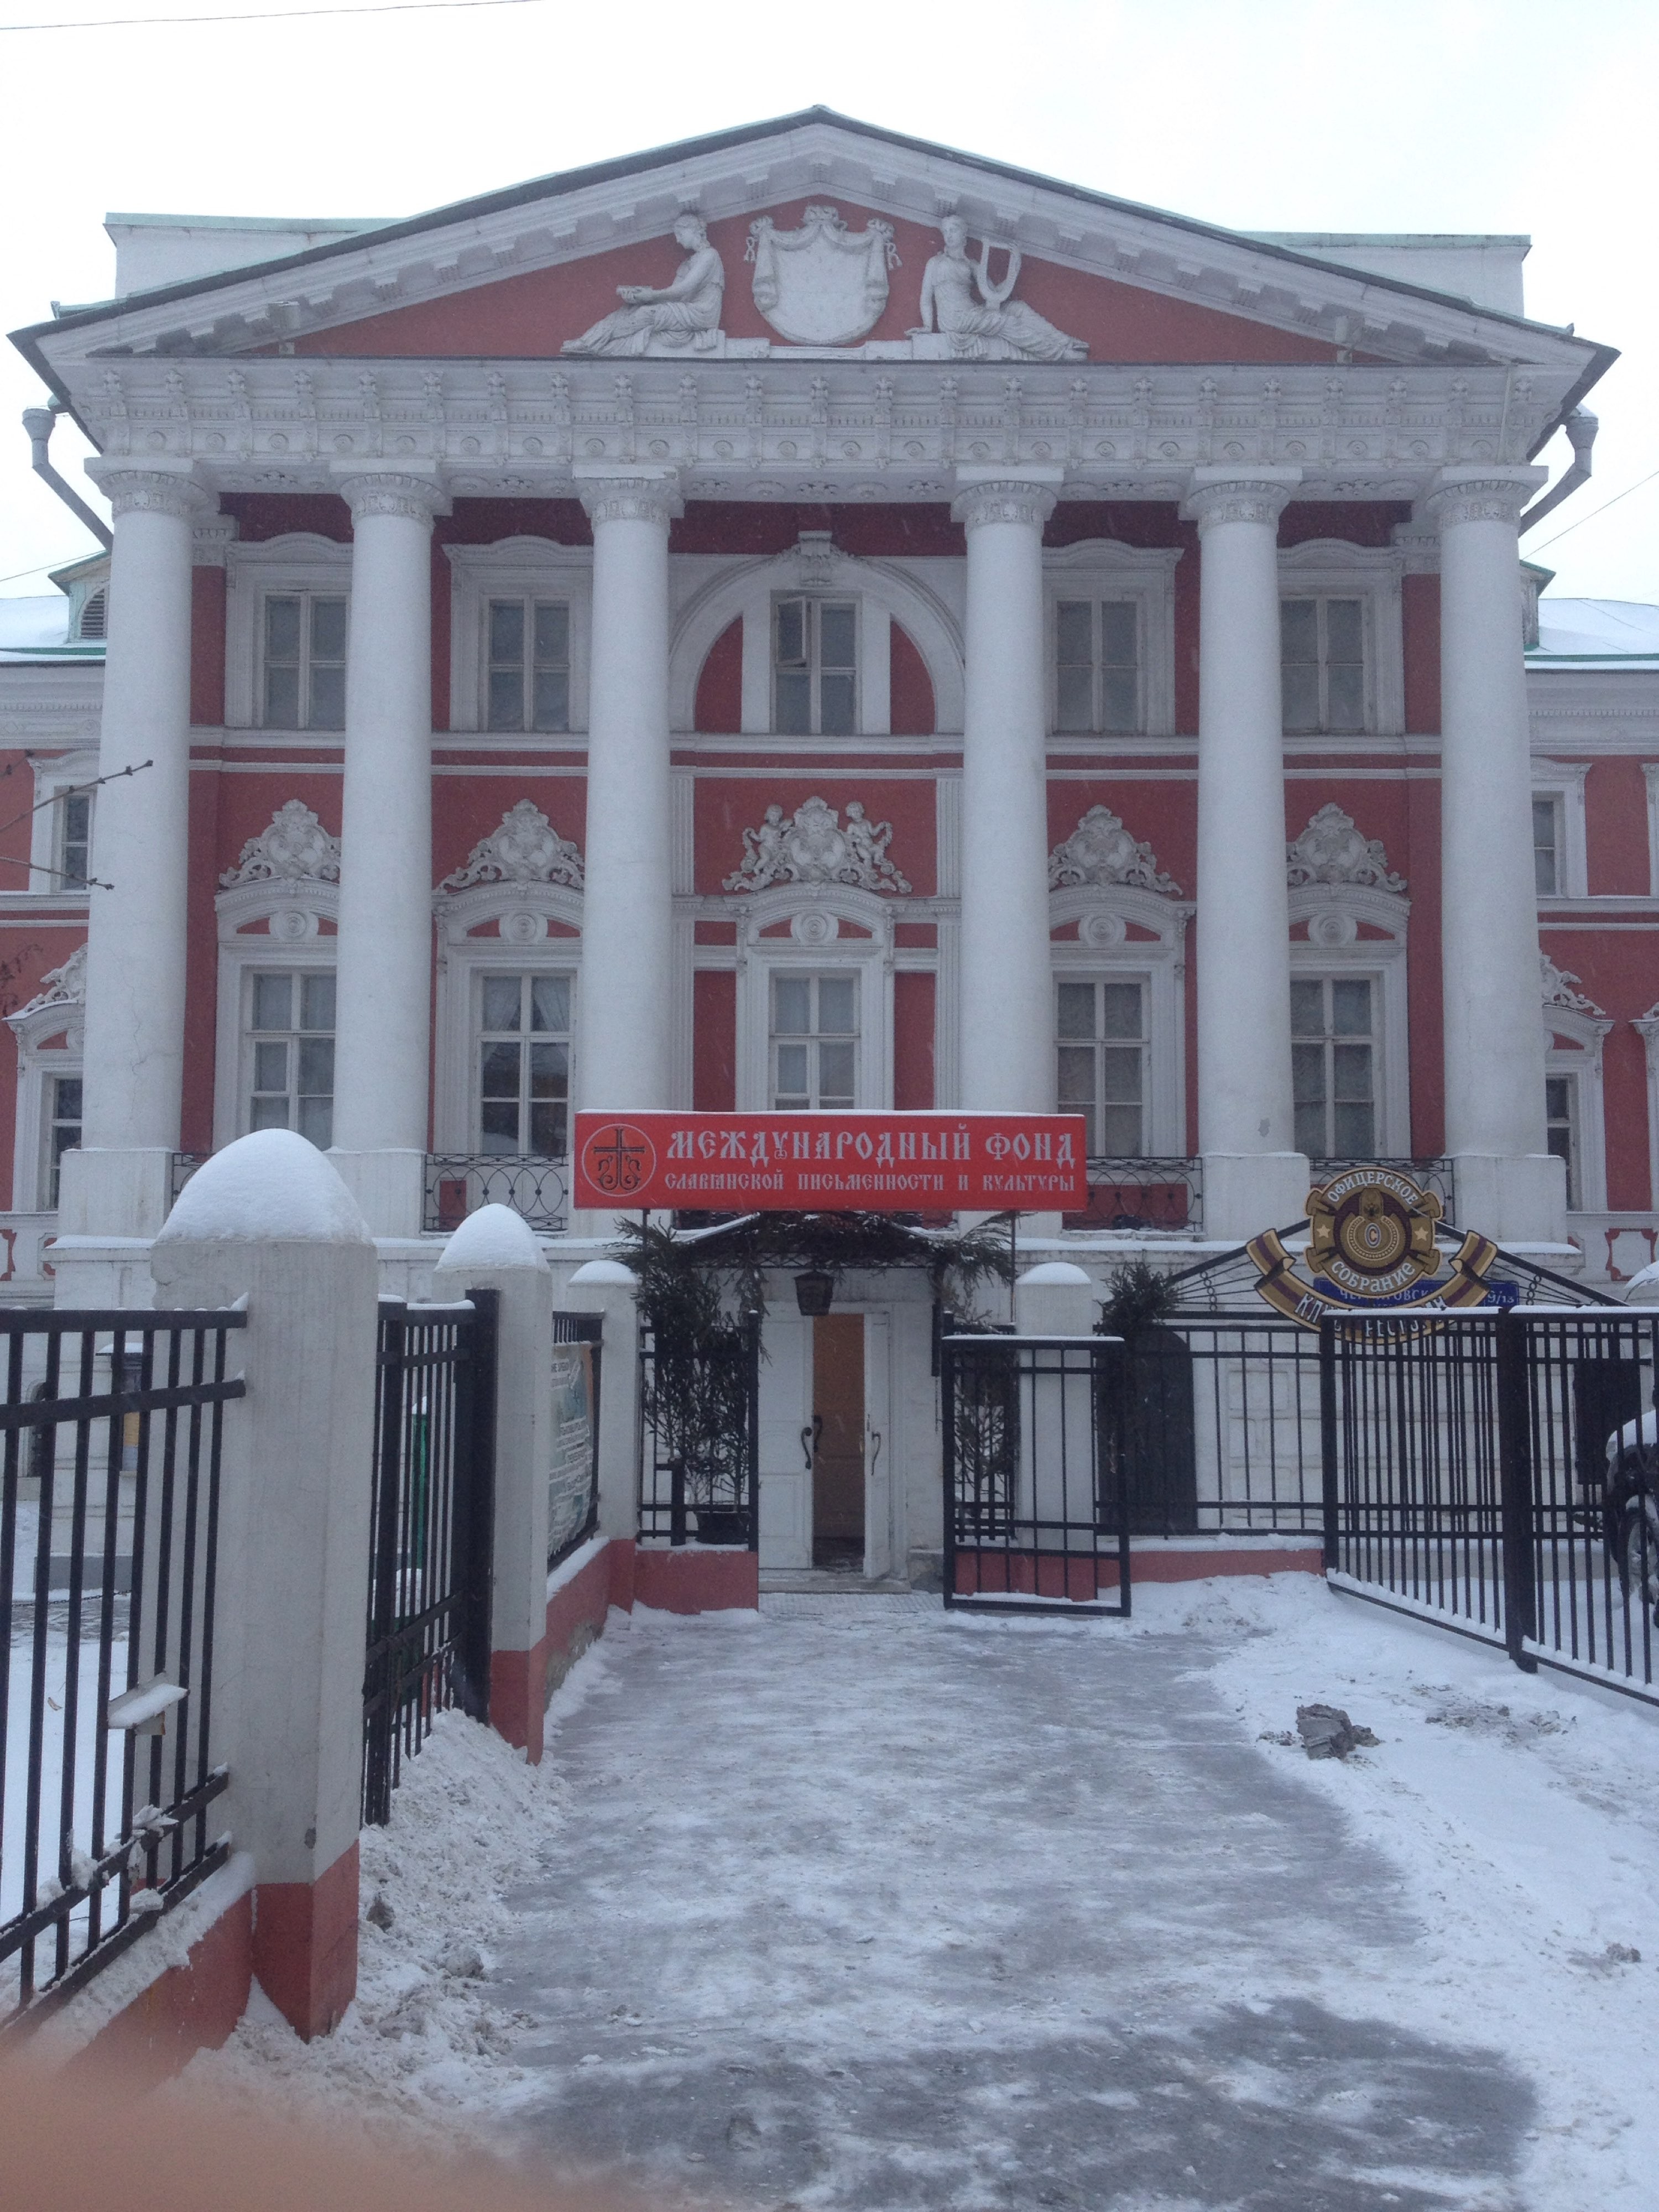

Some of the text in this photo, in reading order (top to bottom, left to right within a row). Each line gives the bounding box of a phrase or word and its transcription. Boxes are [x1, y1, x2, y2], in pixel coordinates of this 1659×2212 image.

[666, 1123, 1076, 1170] МЕЖДУНАРОДНЫЙ ФОНД
[664, 1168, 1075, 1192] СЛАВЯНСКОЙ ПИСЬМЕННОСТИ И КУЛЬТУРЫ
[1327, 1171, 1419, 1204] ОФИЦЕРСКОЕ
[1487, 1290, 1515, 1305] 9/13
